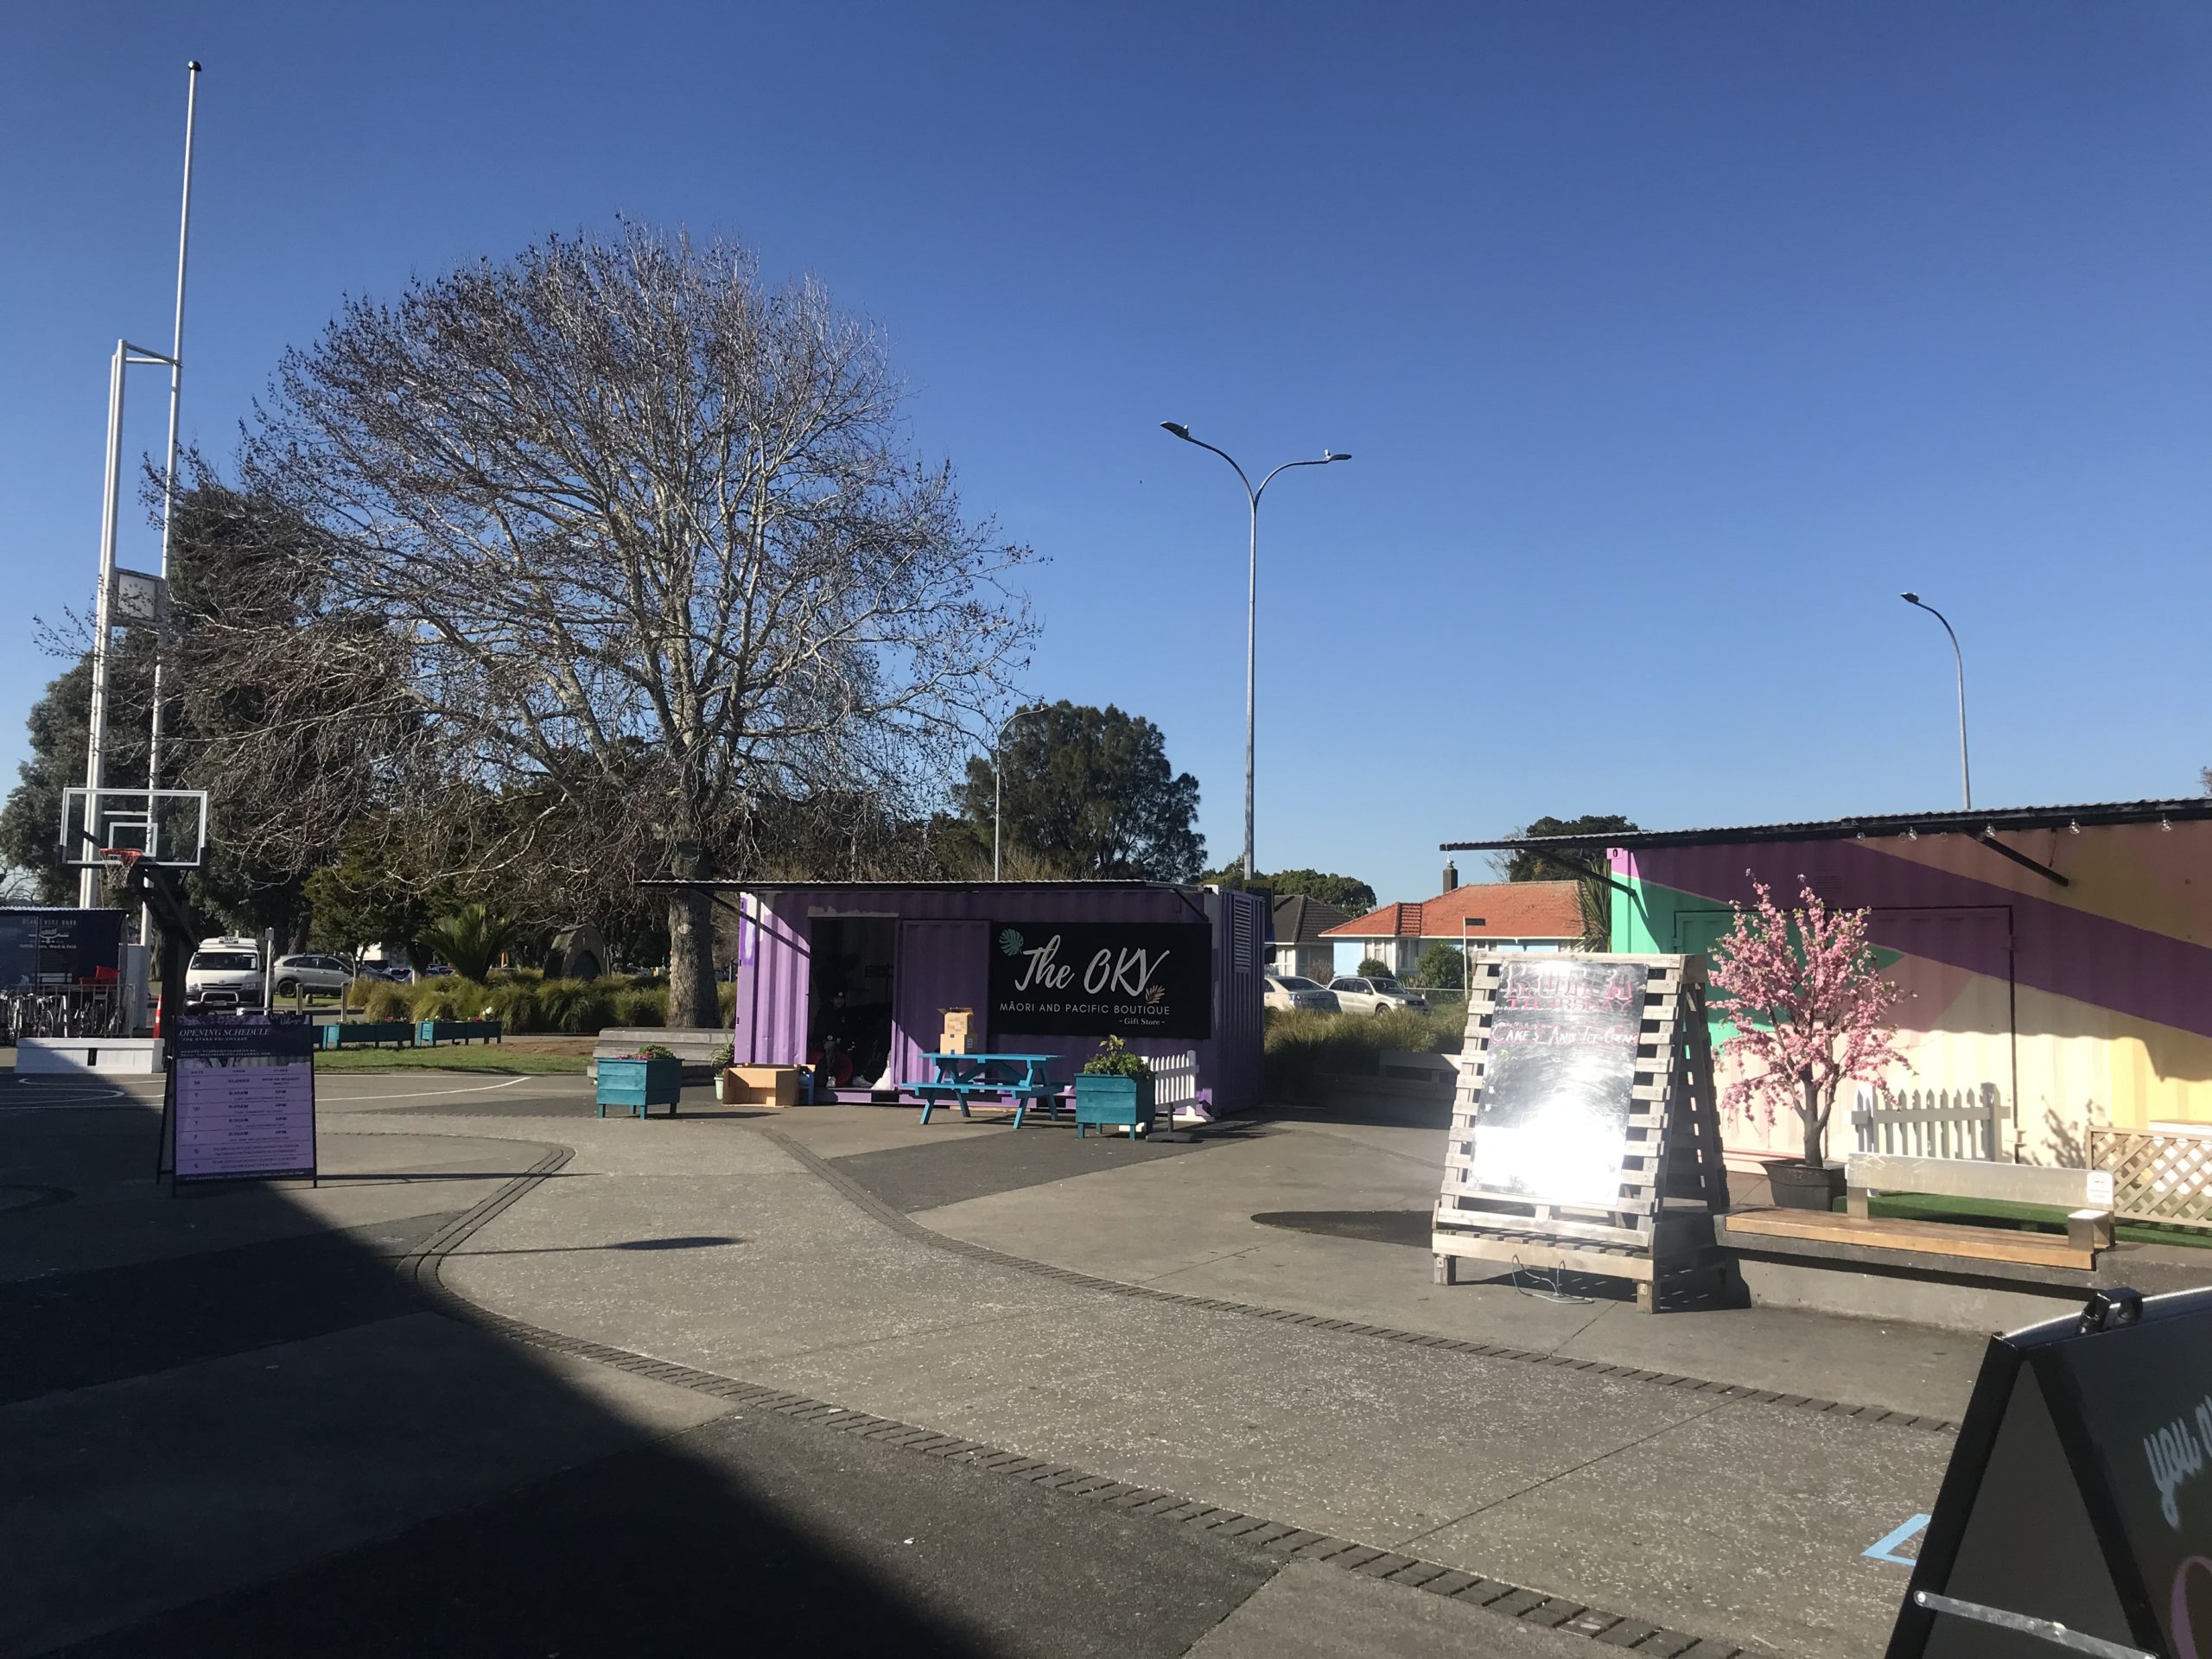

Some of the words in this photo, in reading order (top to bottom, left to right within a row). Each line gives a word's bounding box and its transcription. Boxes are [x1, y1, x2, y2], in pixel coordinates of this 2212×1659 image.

[1014, 934, 1075, 991] The
[1000, 1001, 1034, 1012] MĀORI
[1039, 1003, 1061, 1013] AND
[1065, 1004, 1109, 1014] PACIFIC
[1114, 1005, 1170, 1015] BOUTIQUE
[179, 1028, 222, 1037] OPENING
